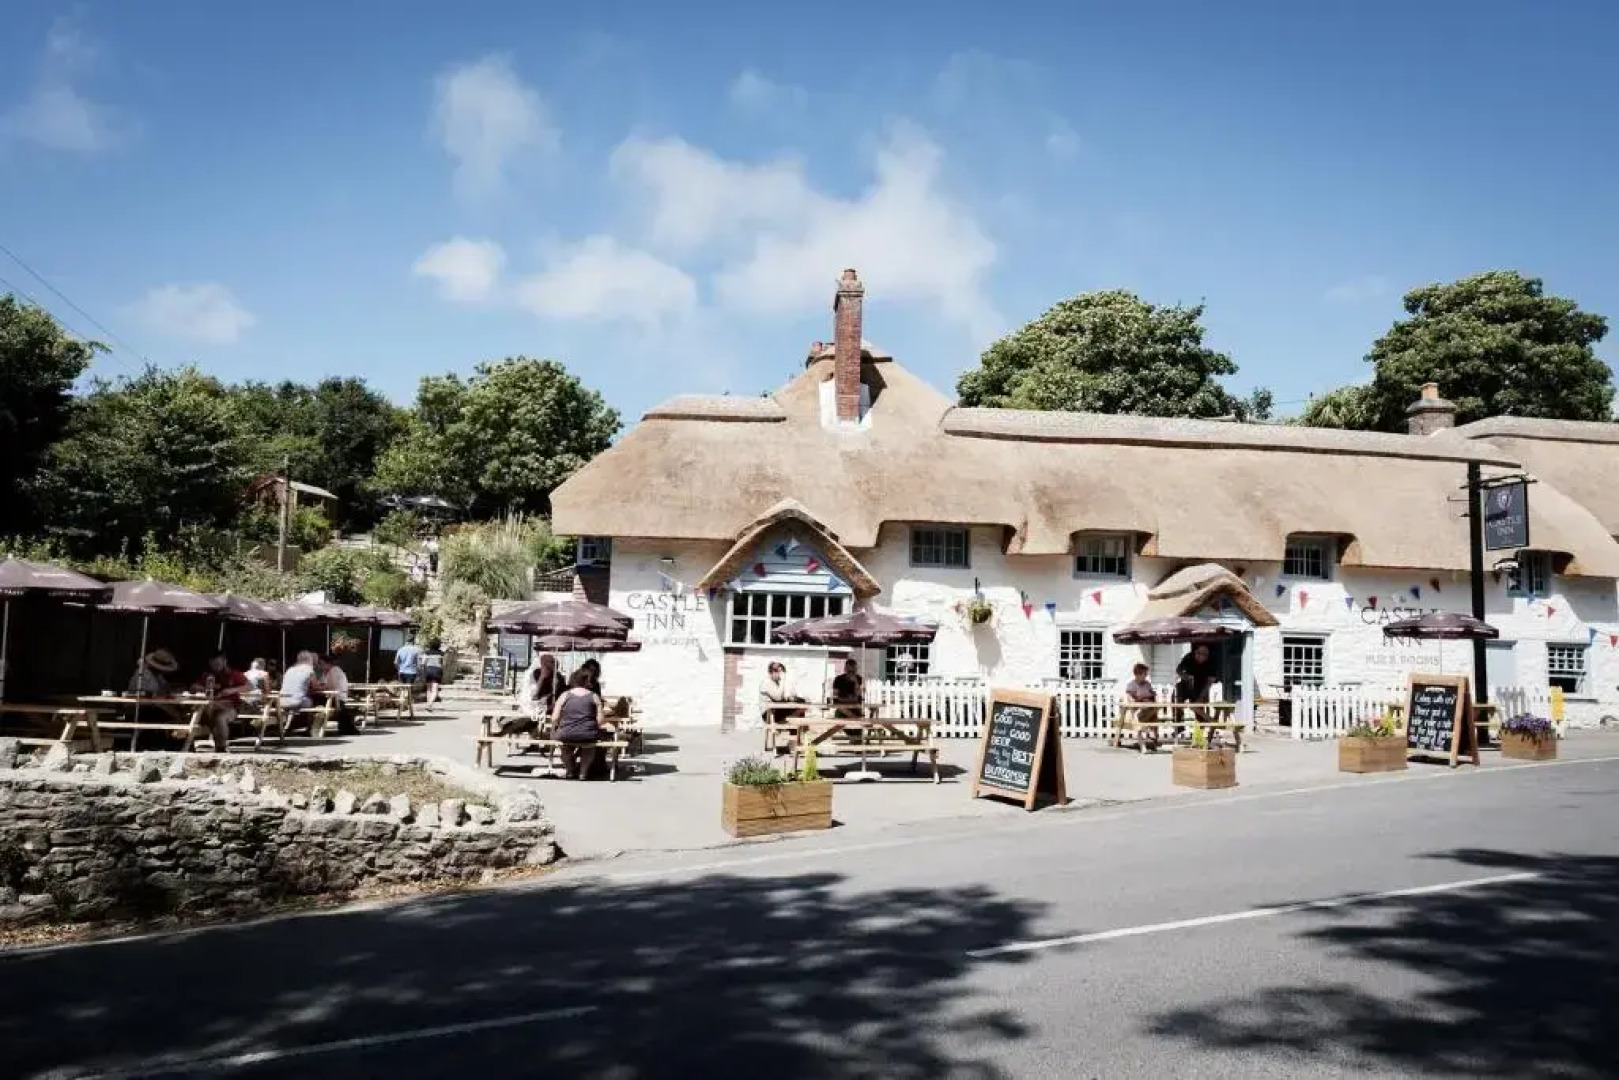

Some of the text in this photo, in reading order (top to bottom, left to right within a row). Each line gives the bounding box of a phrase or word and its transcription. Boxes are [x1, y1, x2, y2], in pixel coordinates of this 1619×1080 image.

[627, 593, 705, 611] CASTLE
[647, 613, 685, 631] INN
[1400, 654, 1440, 666] ROOMS
[994, 712, 1013, 724] GOOD
[1009, 728, 1032, 742] GOOD
